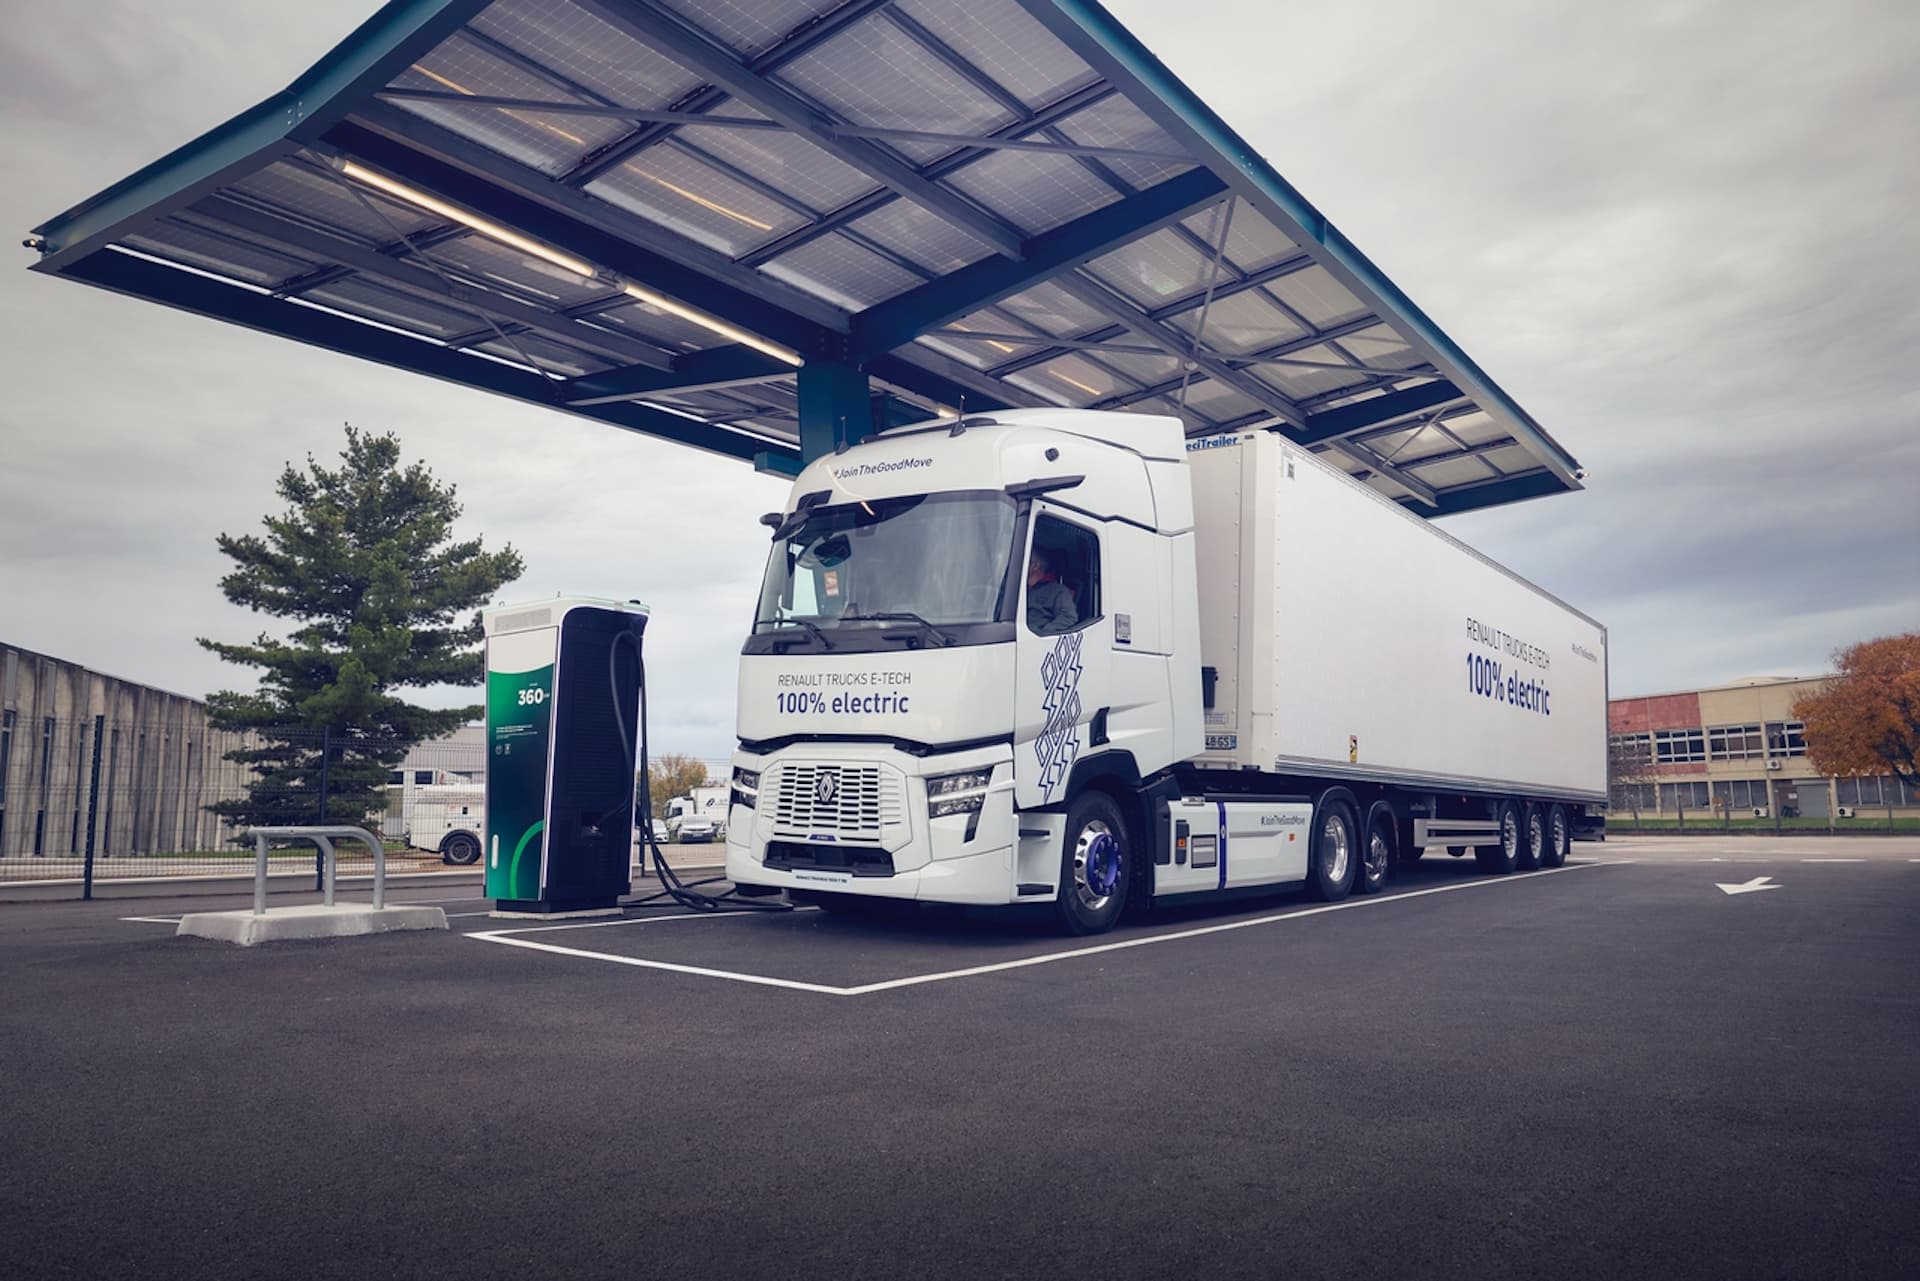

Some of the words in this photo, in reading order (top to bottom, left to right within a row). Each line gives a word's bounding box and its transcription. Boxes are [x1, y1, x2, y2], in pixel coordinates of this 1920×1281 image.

[1467, 617, 1501, 649] RENAULT
[1502, 632, 1528, 662] TRUCKS
[1529, 645, 1550, 670] E-TECH
[778, 674, 823, 686] RENAULT
[826, 673, 868, 686] TRUCKS
[871, 672, 911, 685] E-TECH
[1467, 652, 1504, 701] 100%
[1508, 669, 1550, 716] electric
[518, 688, 544, 706] 360
[777, 692, 826, 714] 100%
[832, 691, 909, 714] electric
